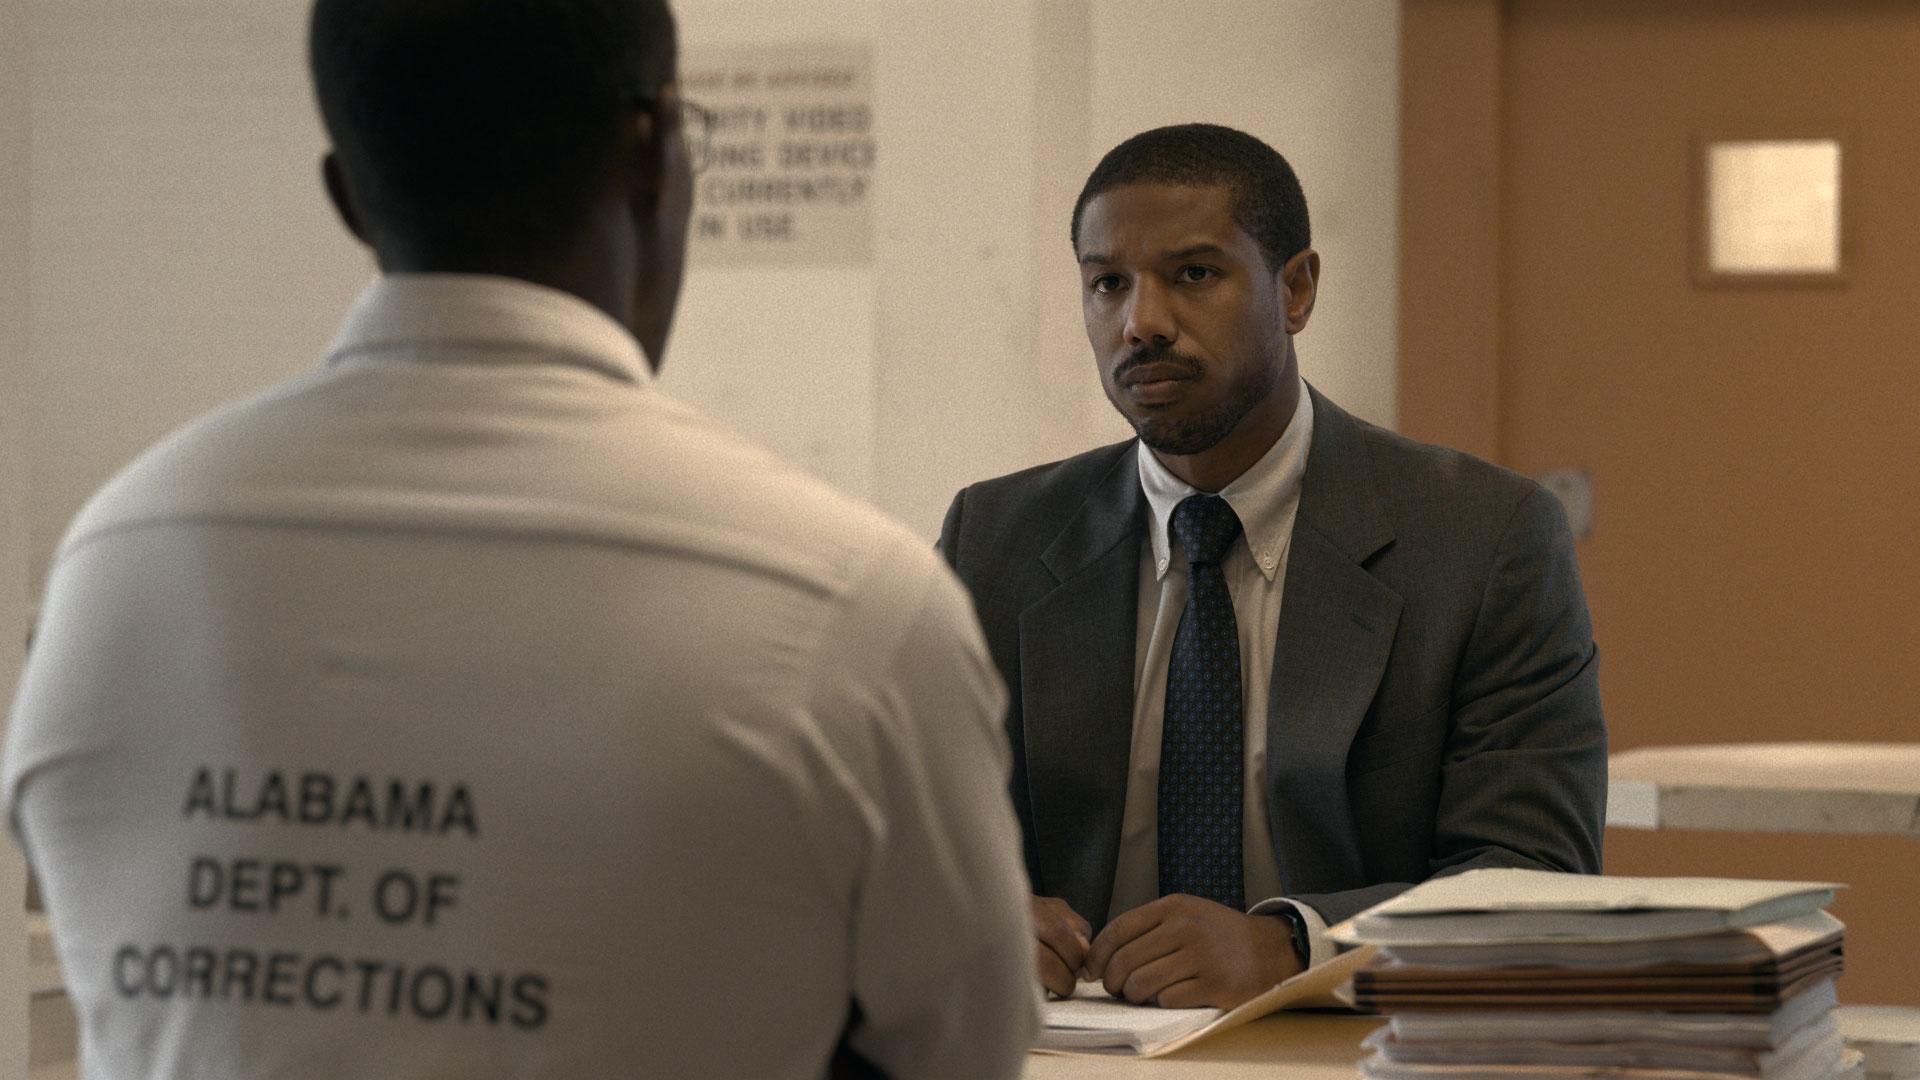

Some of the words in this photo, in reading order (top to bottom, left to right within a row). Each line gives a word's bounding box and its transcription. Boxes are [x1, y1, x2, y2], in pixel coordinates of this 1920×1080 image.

[785, 105, 872, 132] VIDEO
[703, 177, 868, 205] CURRENTLY
[182, 766, 480, 838] ALABAMA
[187, 856, 350, 919] DEPT.
[373, 869, 463, 927] OF
[112, 944, 552, 1029] CORRECTIONS
